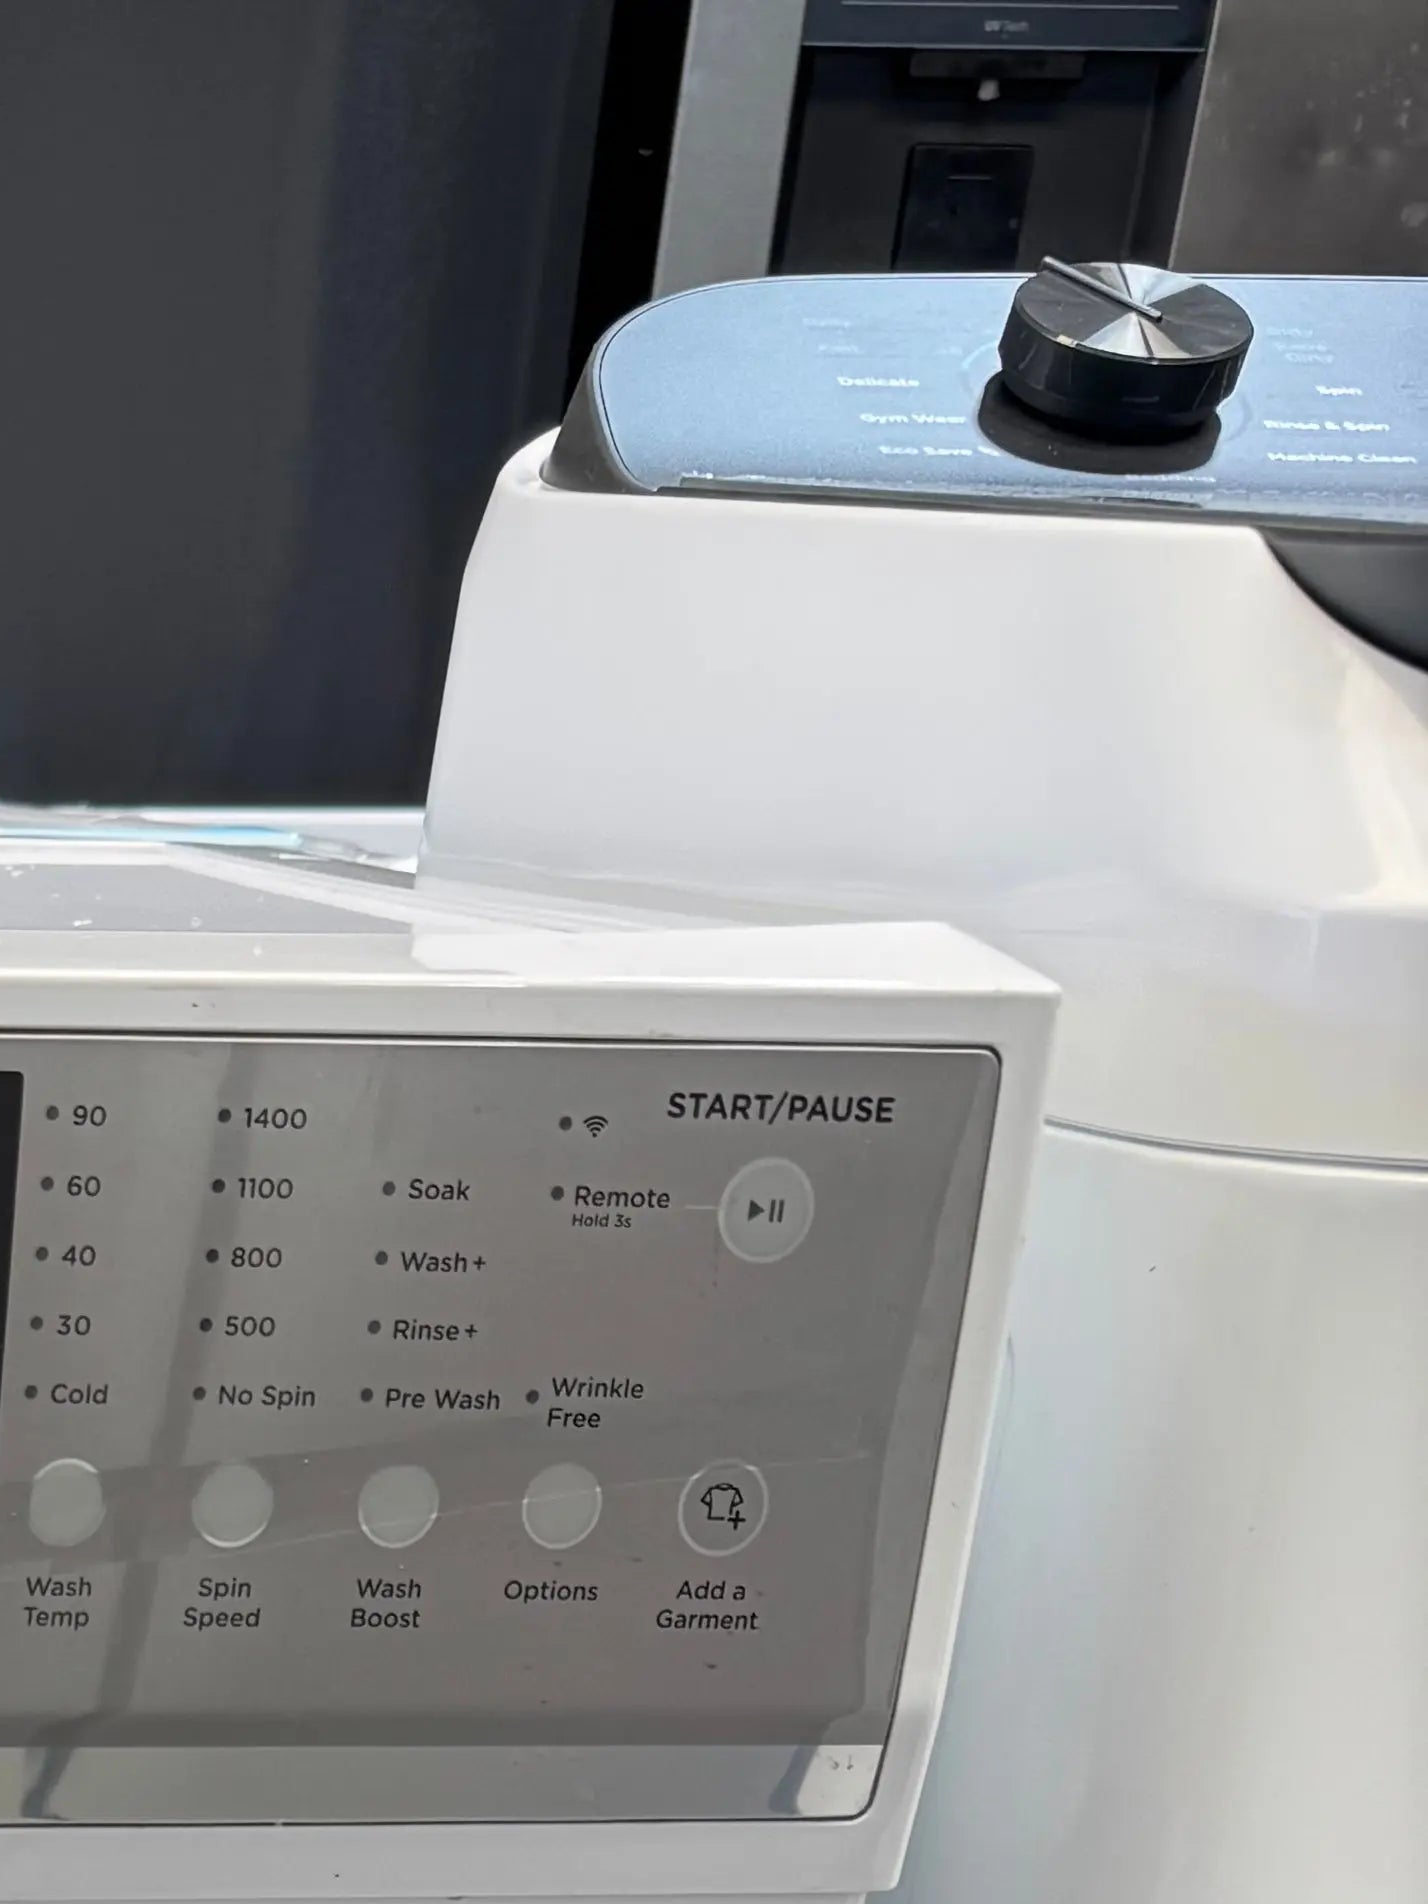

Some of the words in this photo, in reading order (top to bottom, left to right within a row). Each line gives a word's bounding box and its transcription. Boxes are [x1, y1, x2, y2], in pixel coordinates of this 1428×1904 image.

[836, 376, 920, 387] Delicate
[72, 1105, 107, 1127] 90
[244, 1107, 307, 1130] 1400
[666, 1091, 896, 1125] START/PAUSE
[66, 1175, 101, 1197] 60
[238, 1177, 293, 1200] 1100
[408, 1178, 470, 1201] Soak
[574, 1184, 671, 1210] Remote
[571, 1213, 609, 1229] Hold
[614, 1213, 632, 1229] 3s
[61, 1245, 96, 1267] 40
[231, 1247, 283, 1269] 800
[56, 1314, 91, 1337] 30
[225, 1316, 276, 1338] 500
[50, 1383, 108, 1405] Cold
[218, 1385, 253, 1407] No
[261, 1385, 316, 1410] Spin
[551, 1376, 645, 1400] Wrinkle
[385, 1388, 425, 1409] Pre
[435, 1388, 501, 1411] Wash
[546, 1407, 601, 1429] Free
[26, 1576, 92, 1598] Wash
[198, 1576, 252, 1601] Spin
[357, 1578, 422, 1600] Wash
[504, 1579, 599, 1604] Options
[676, 1580, 726, 1601] Add
[733, 1585, 746, 1601] a
[24, 1606, 90, 1631] Temp
[183, 1606, 261, 1630] Speed
[350, 1607, 420, 1629] Boost
[656, 1608, 760, 1630] Garment
